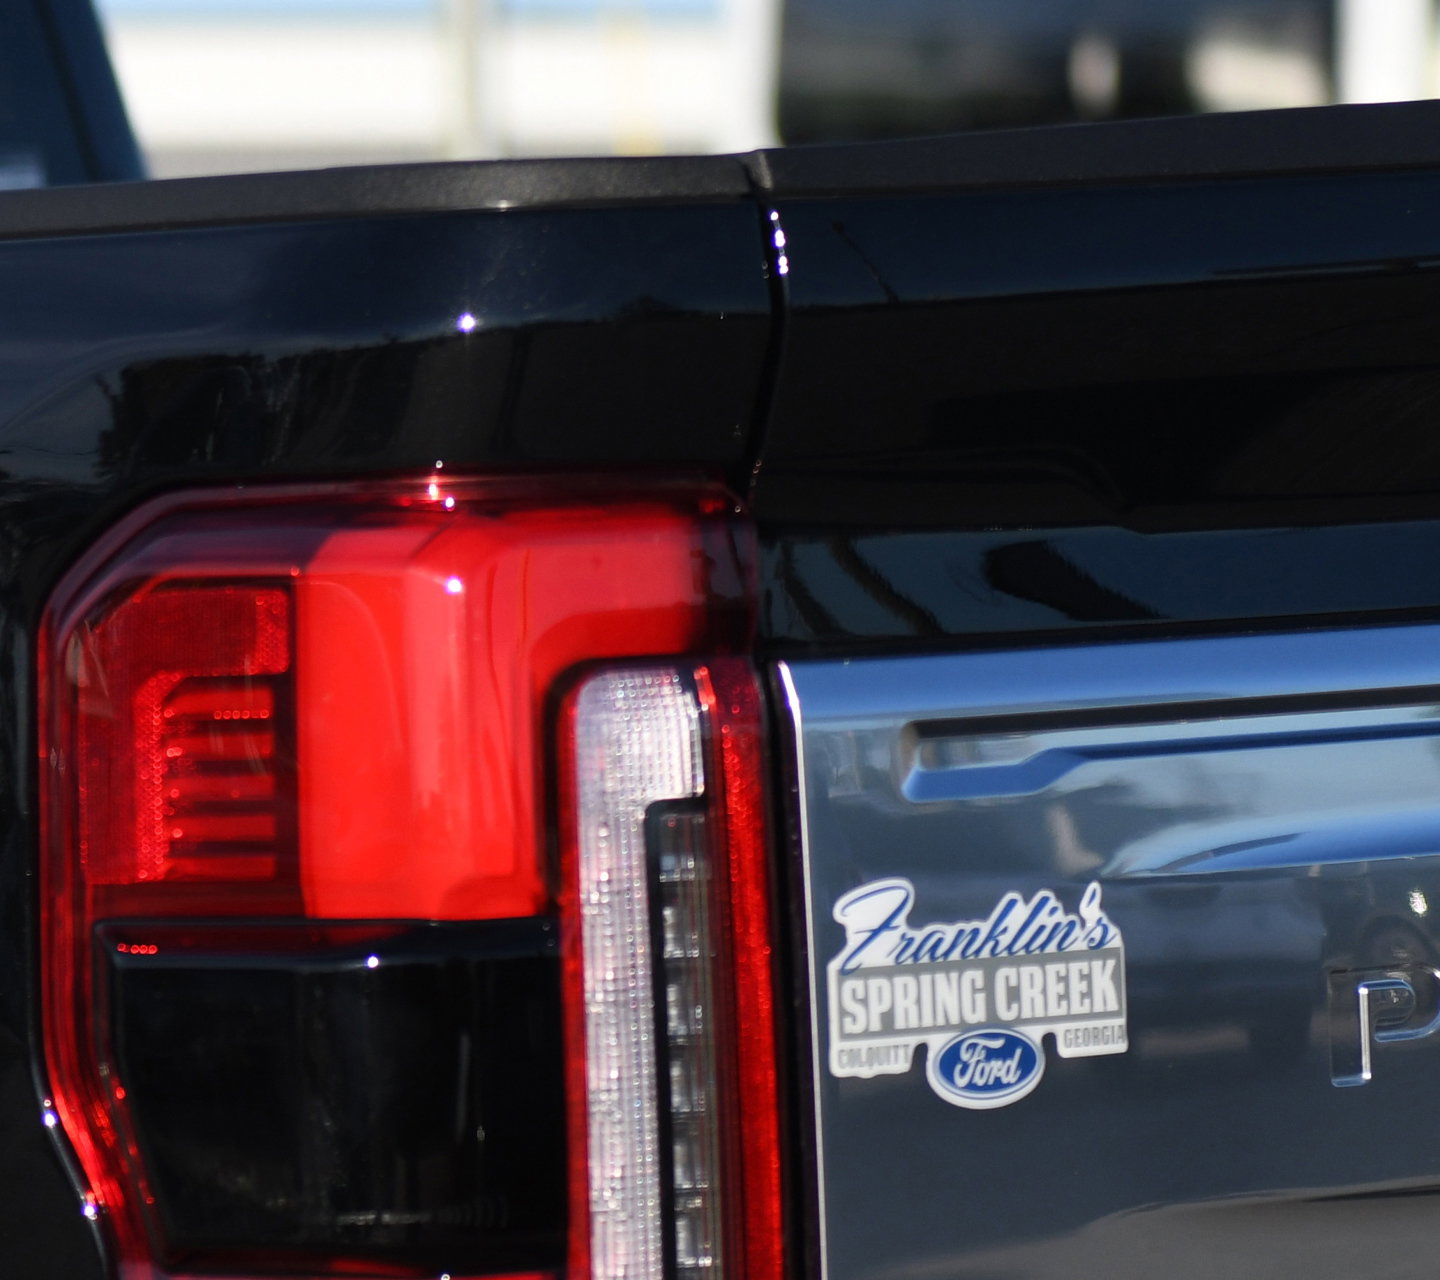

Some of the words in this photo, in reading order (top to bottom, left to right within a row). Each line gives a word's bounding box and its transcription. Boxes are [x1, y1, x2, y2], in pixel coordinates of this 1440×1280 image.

[839, 884, 1117, 976] Franklin's
[840, 968, 988, 1035] SPRING
[994, 958, 1120, 1022] CREEK
[952, 1036, 1024, 1088] Ford
[1063, 1022, 1125, 1050] GEORGIA
